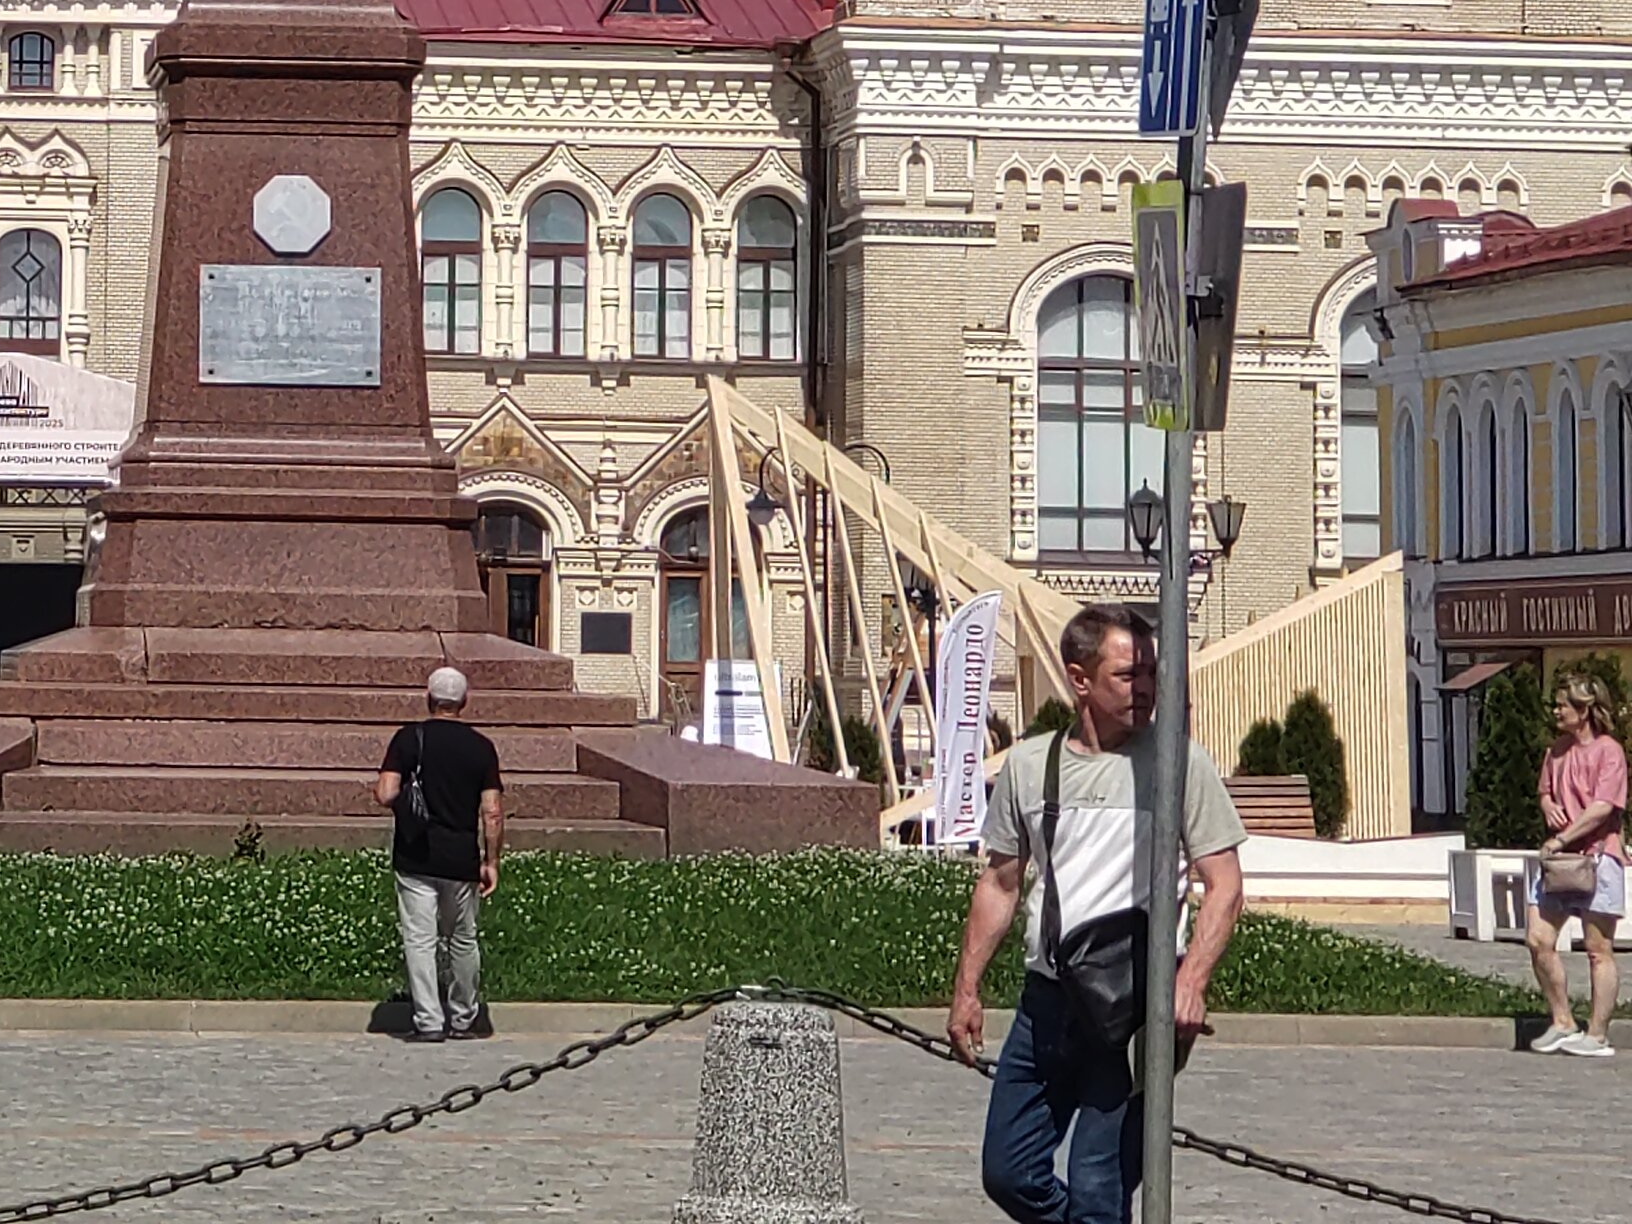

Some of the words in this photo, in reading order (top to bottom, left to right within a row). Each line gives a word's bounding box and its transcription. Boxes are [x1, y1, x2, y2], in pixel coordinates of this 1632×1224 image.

[40, 419, 64, 428] 2025
[1454, 591, 1508, 633] КРАСНЫЙ
[1522, 587, 1597, 632] ГОСТИННЫЙ
[1614, 594, 1632, 636] ДВ
[957, 624, 985, 732] Леонардо
[954, 752, 976, 837] Мастер
